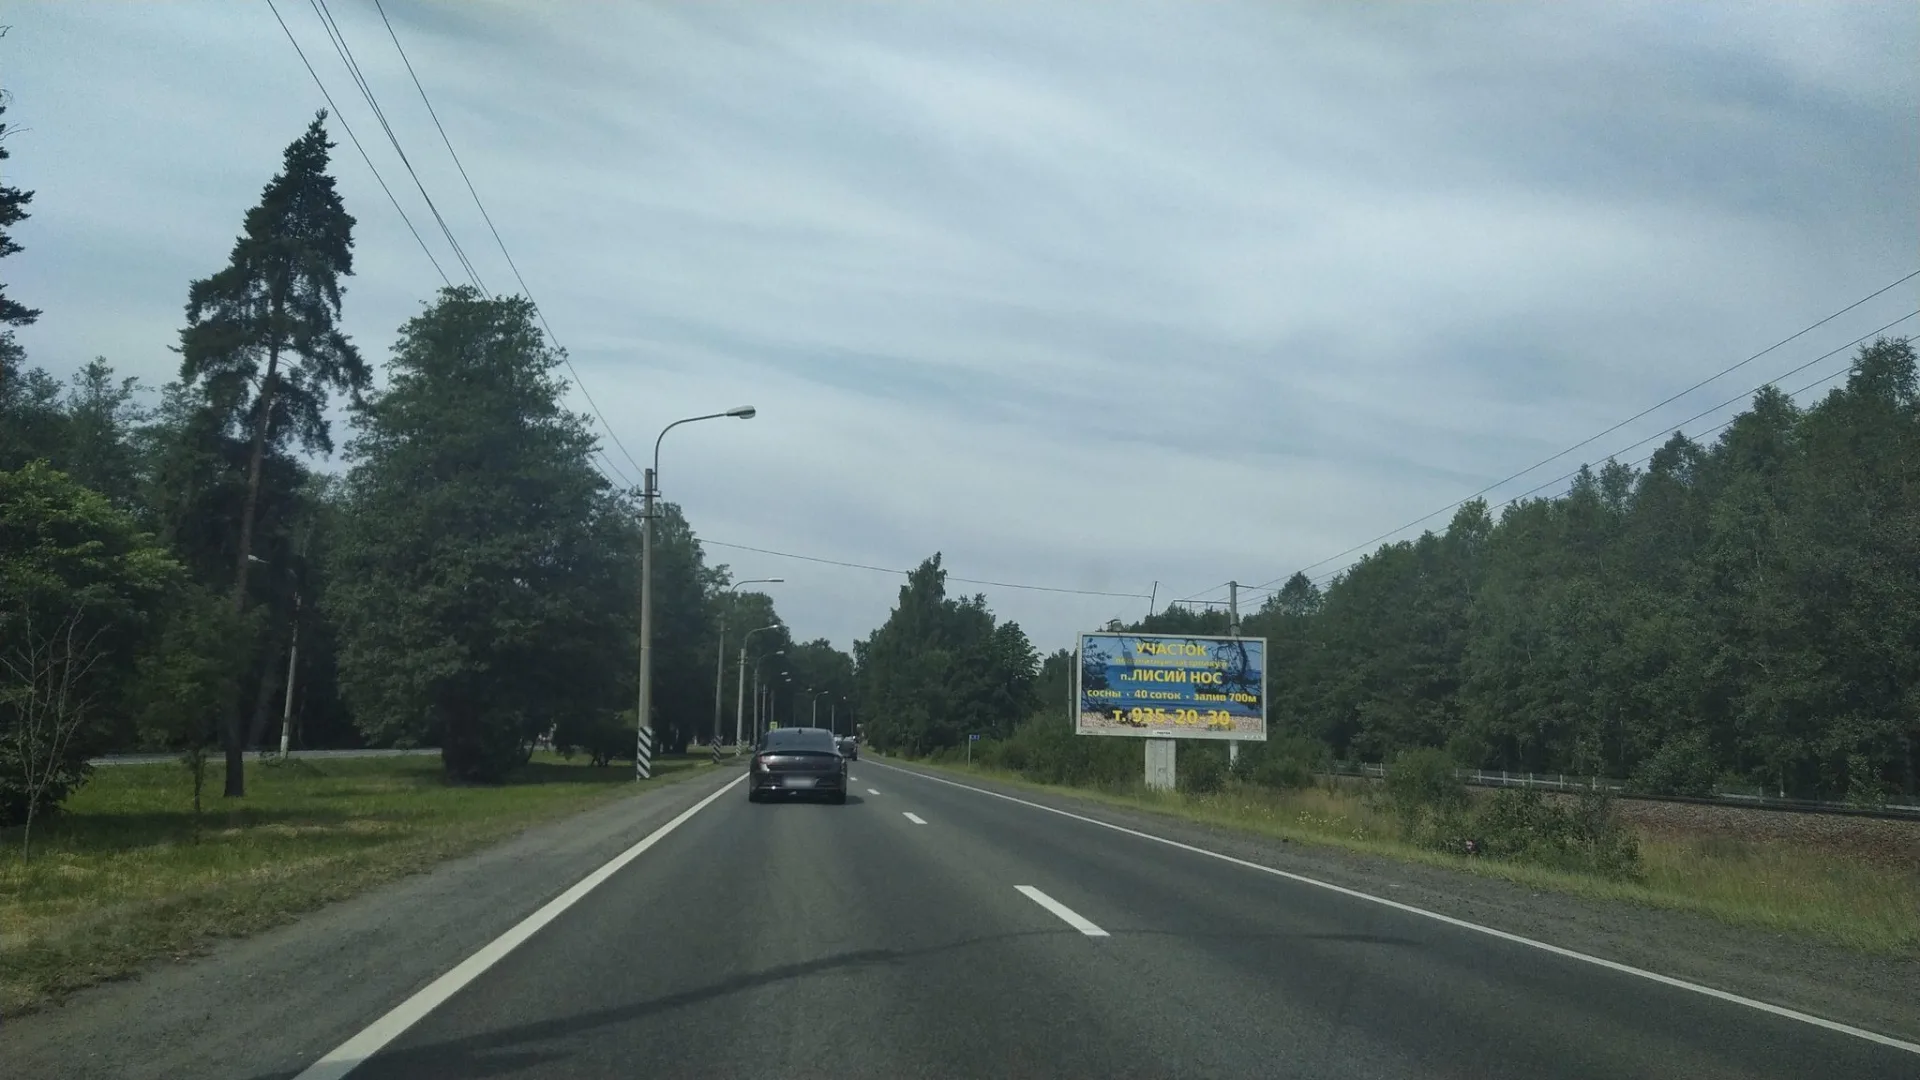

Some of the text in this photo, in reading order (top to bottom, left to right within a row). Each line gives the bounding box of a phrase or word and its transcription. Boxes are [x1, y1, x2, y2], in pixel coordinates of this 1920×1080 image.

[1136, 642, 1208, 657] УЧАСТОК
[1190, 671, 1223, 685] НОС
[1087, 689, 1257, 703] сосны 40 соток залив 700м
[1112, 707, 1231, 725] т. 935-20-30
